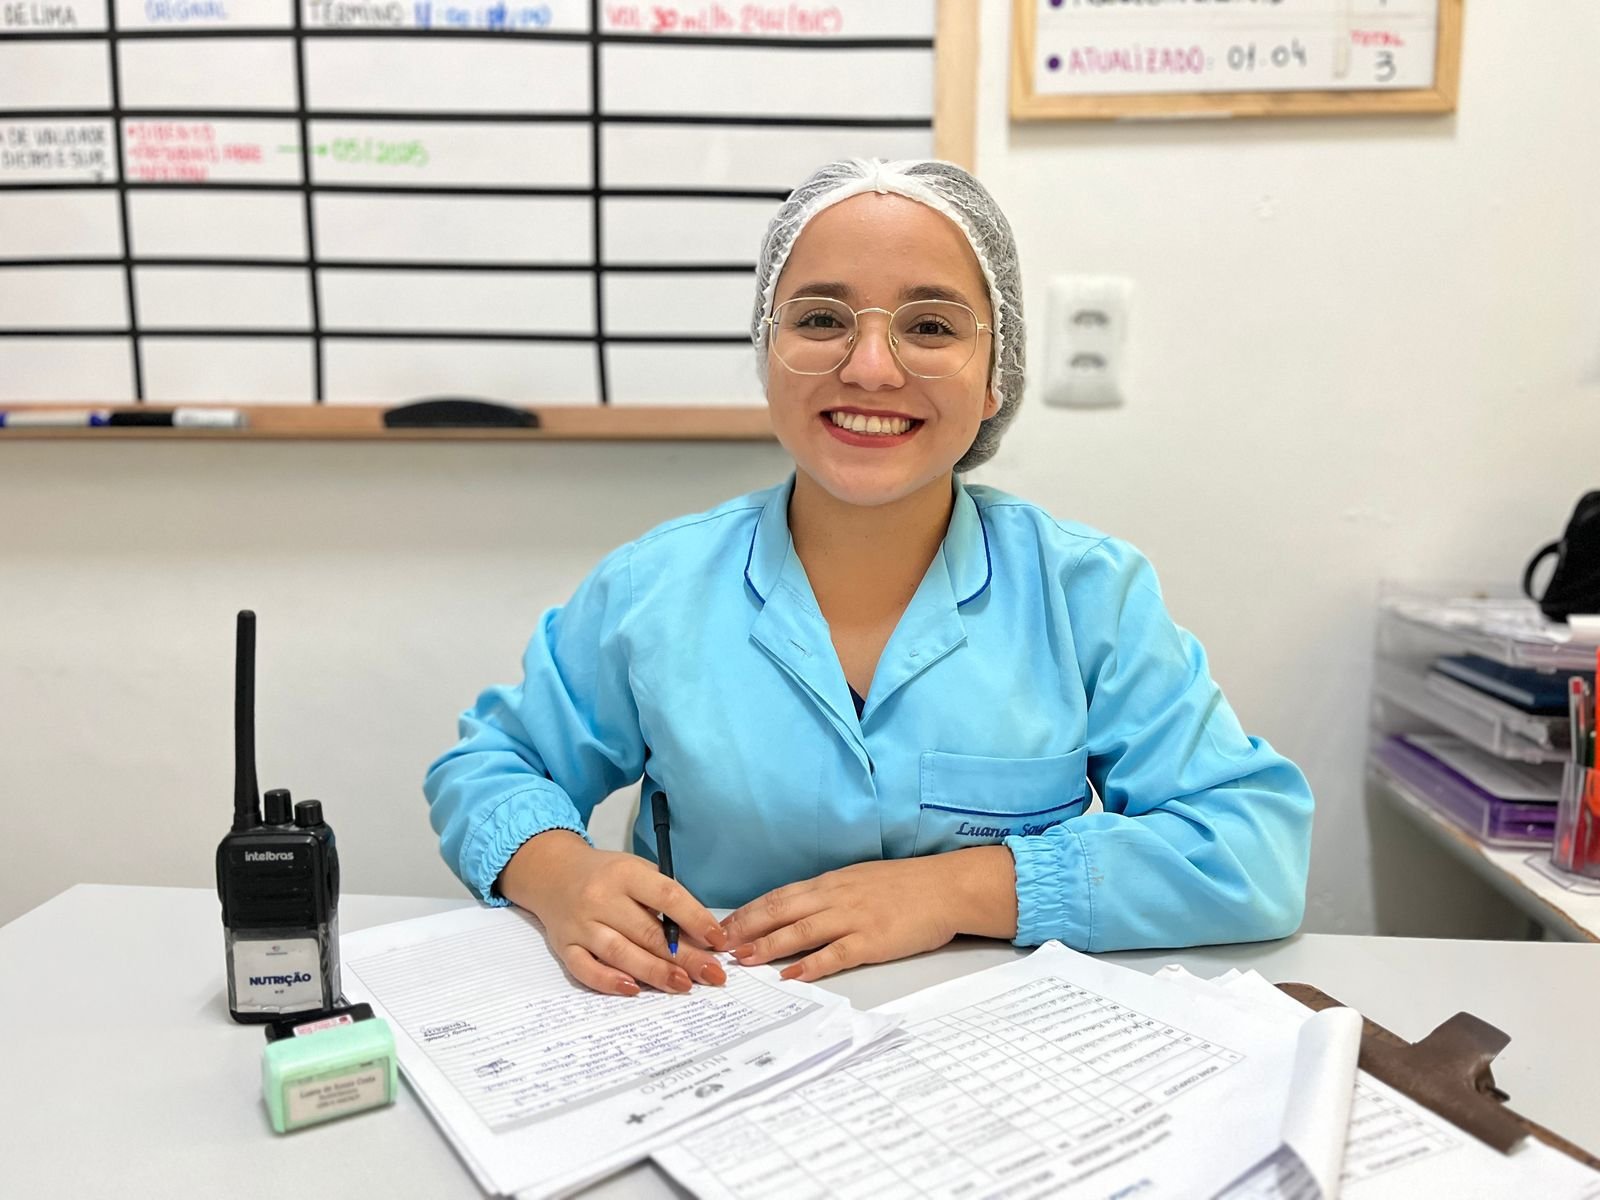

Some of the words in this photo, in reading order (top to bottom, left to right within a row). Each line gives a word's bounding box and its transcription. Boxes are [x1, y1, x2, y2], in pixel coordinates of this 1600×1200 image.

[1373, 51, 1397, 82] 3
[955, 822, 1011, 838] Luana
[245, 851, 294, 862] intelbras
[249, 971, 312, 988] NUTRIÇÃO
